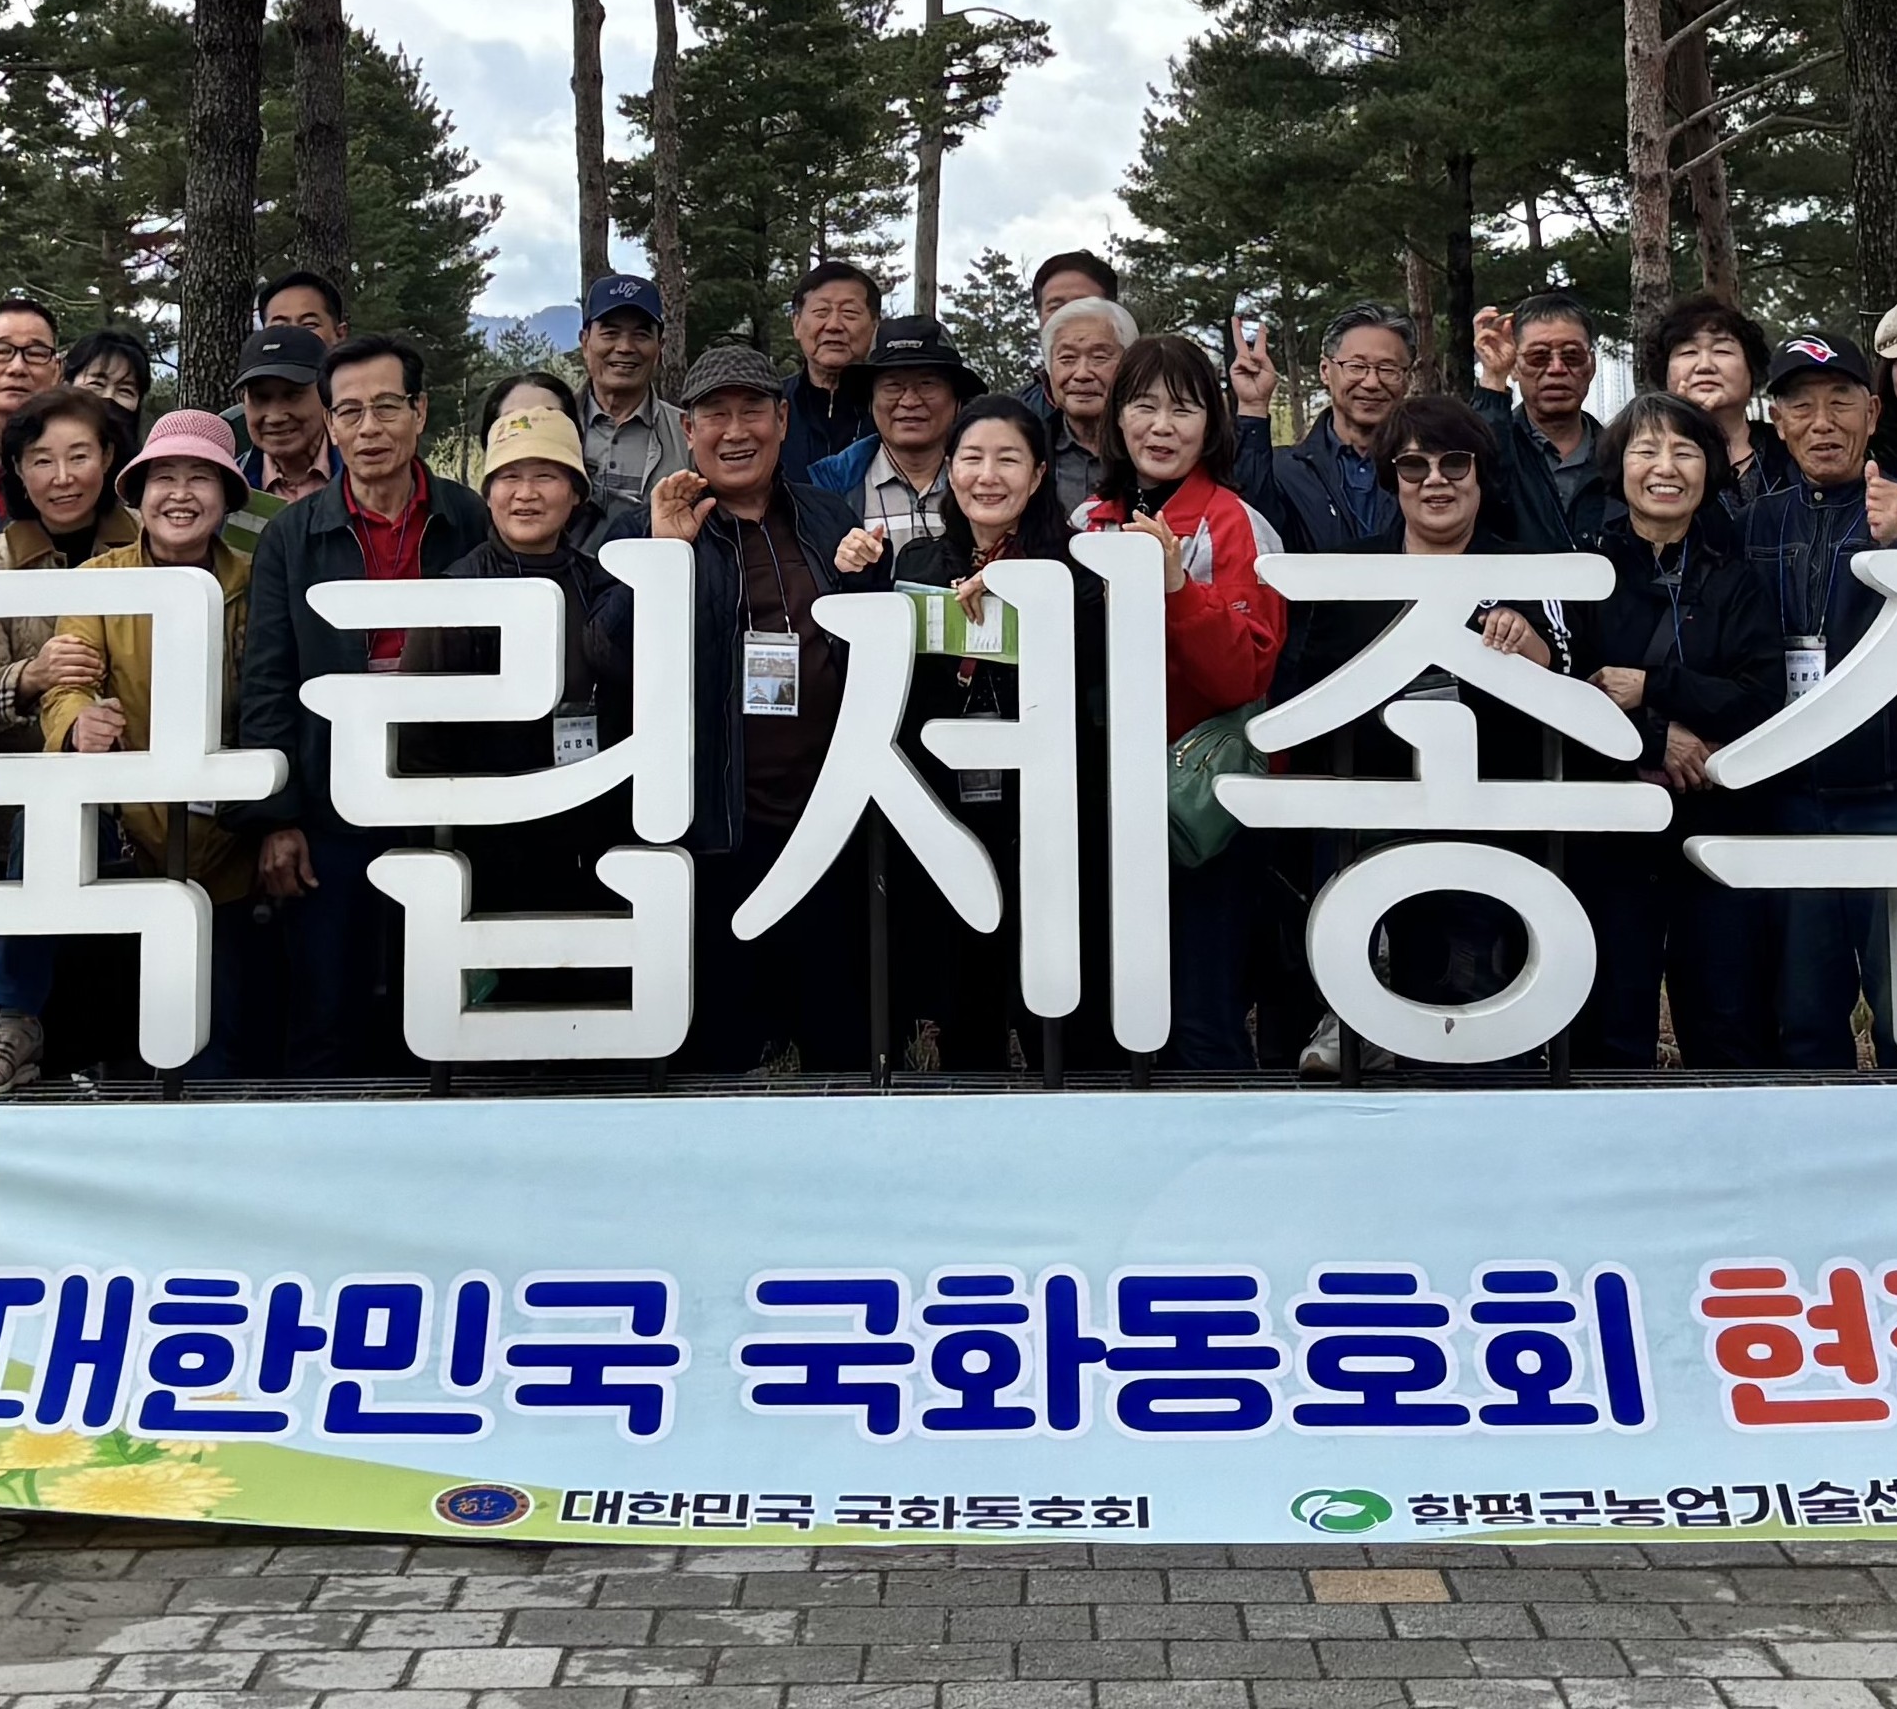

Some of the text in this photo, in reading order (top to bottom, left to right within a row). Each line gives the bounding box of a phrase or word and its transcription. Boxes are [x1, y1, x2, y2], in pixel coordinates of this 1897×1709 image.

[739, 1268, 1647, 1438] 국화동호회
[560, 1489, 816, 1529] 대한민국
[833, 1494, 1151, 1530] 국화동호회
